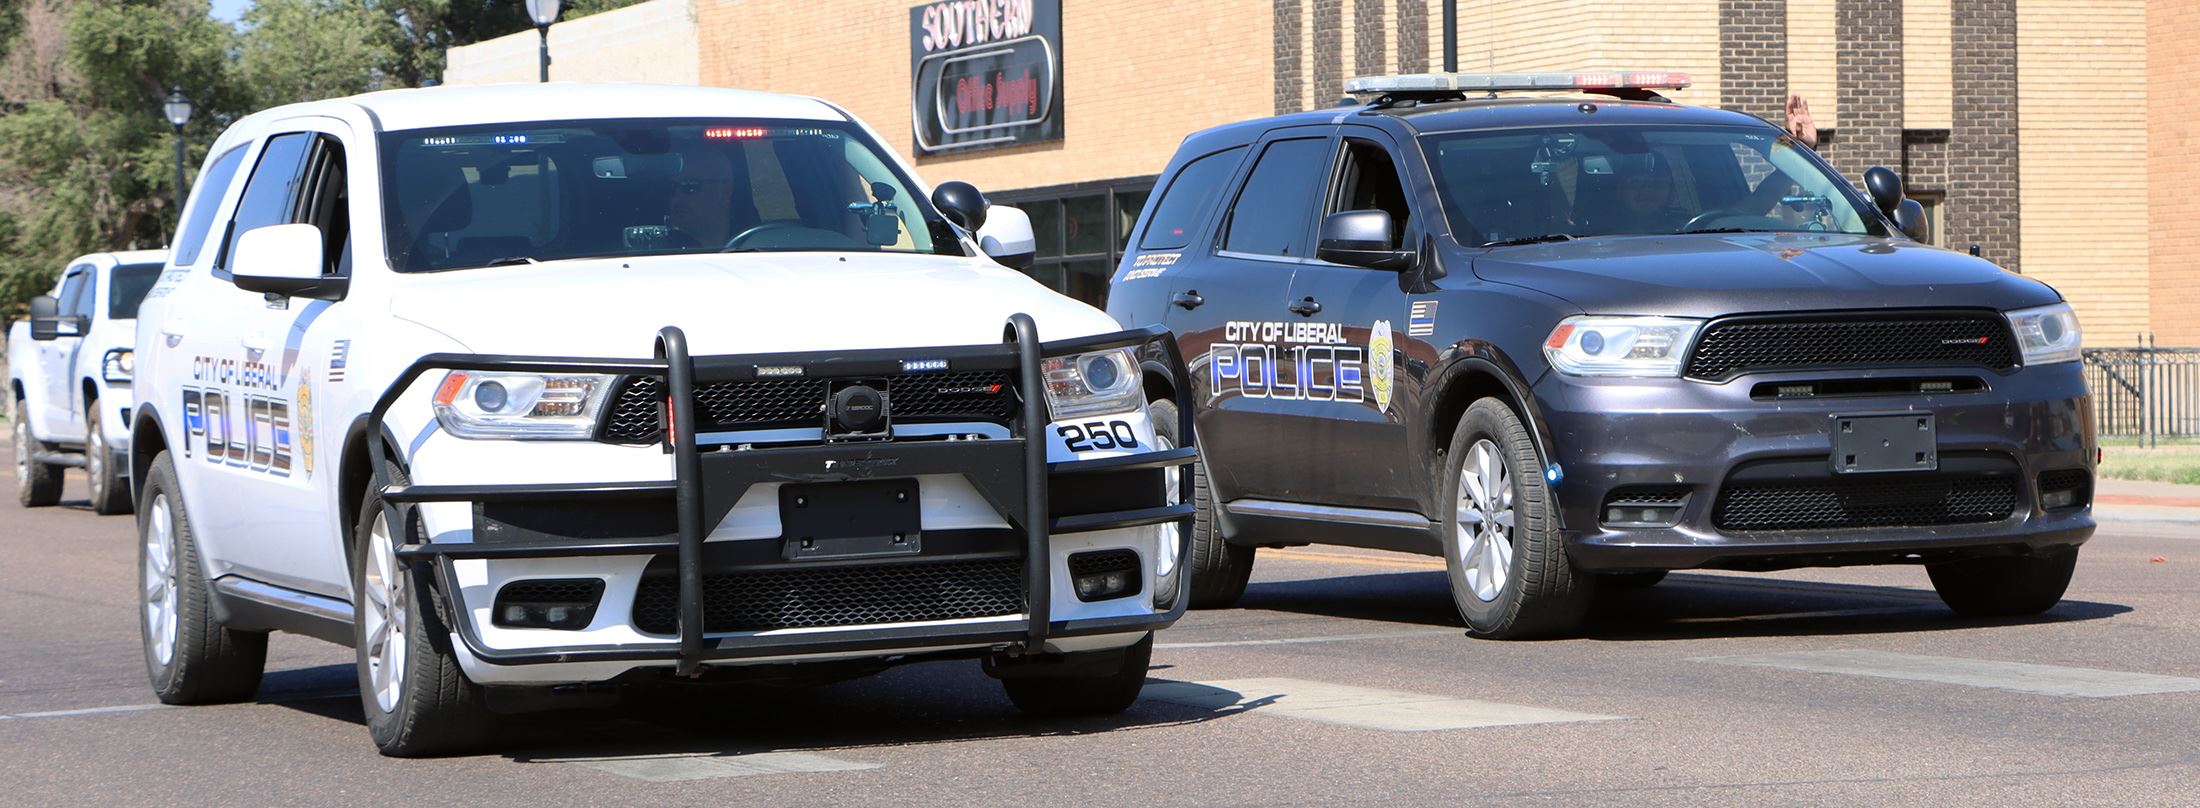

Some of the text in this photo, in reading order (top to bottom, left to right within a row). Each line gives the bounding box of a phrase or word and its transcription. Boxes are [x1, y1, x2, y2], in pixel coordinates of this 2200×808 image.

[922, 0, 1033, 51] SOUTHERN
[957, 68, 1037, 115] Office Supply
[1225, 321, 1347, 343] CITY OF LIBERAL
[194, 356, 278, 391] CITY OF LIBERAL
[937, 386, 992, 394] DODGE
[1210, 343, 1364, 403] POLICE
[182, 385, 291, 477] POLICE
[1056, 420, 1139, 453] 250
